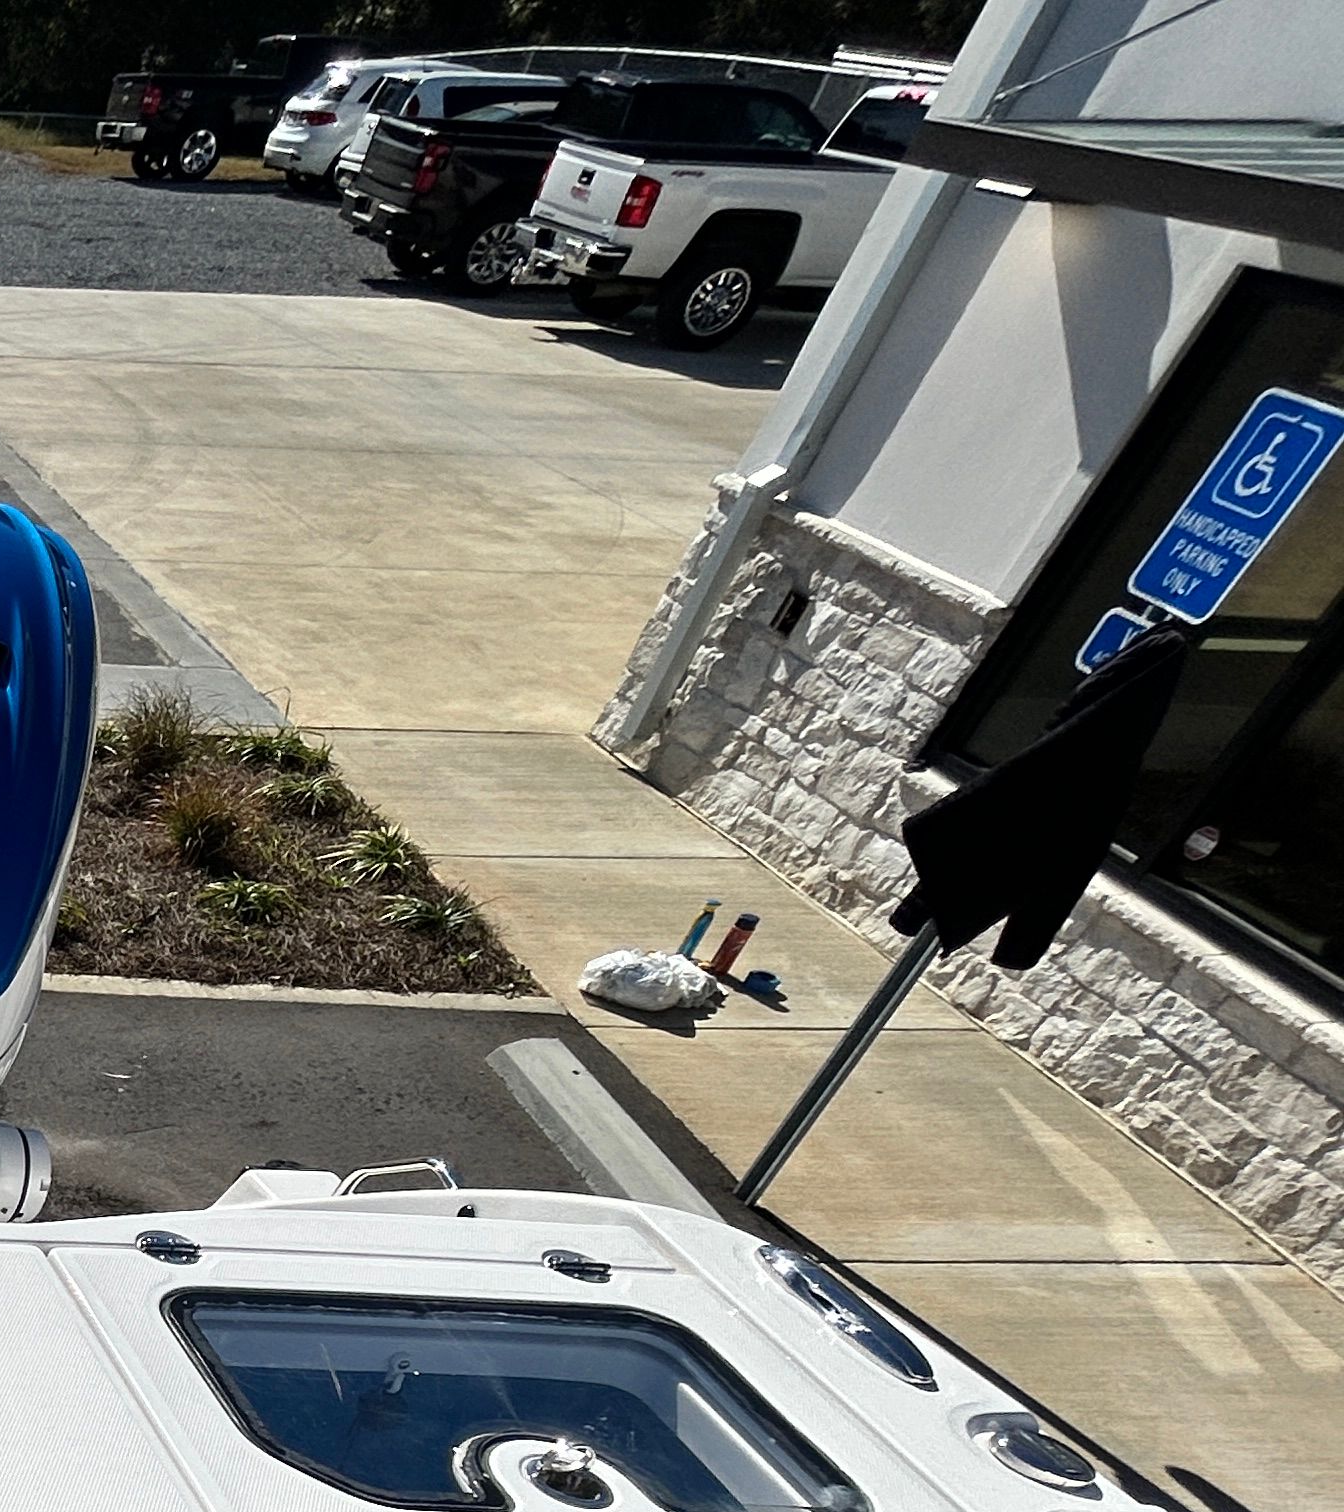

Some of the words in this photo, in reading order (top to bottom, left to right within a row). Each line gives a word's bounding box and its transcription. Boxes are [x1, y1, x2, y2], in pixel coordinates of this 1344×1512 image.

[1175, 507, 1261, 558] HANDICAPPED
[1169, 538, 1229, 577] PARKING
[1162, 567, 1202, 596] ONLY
